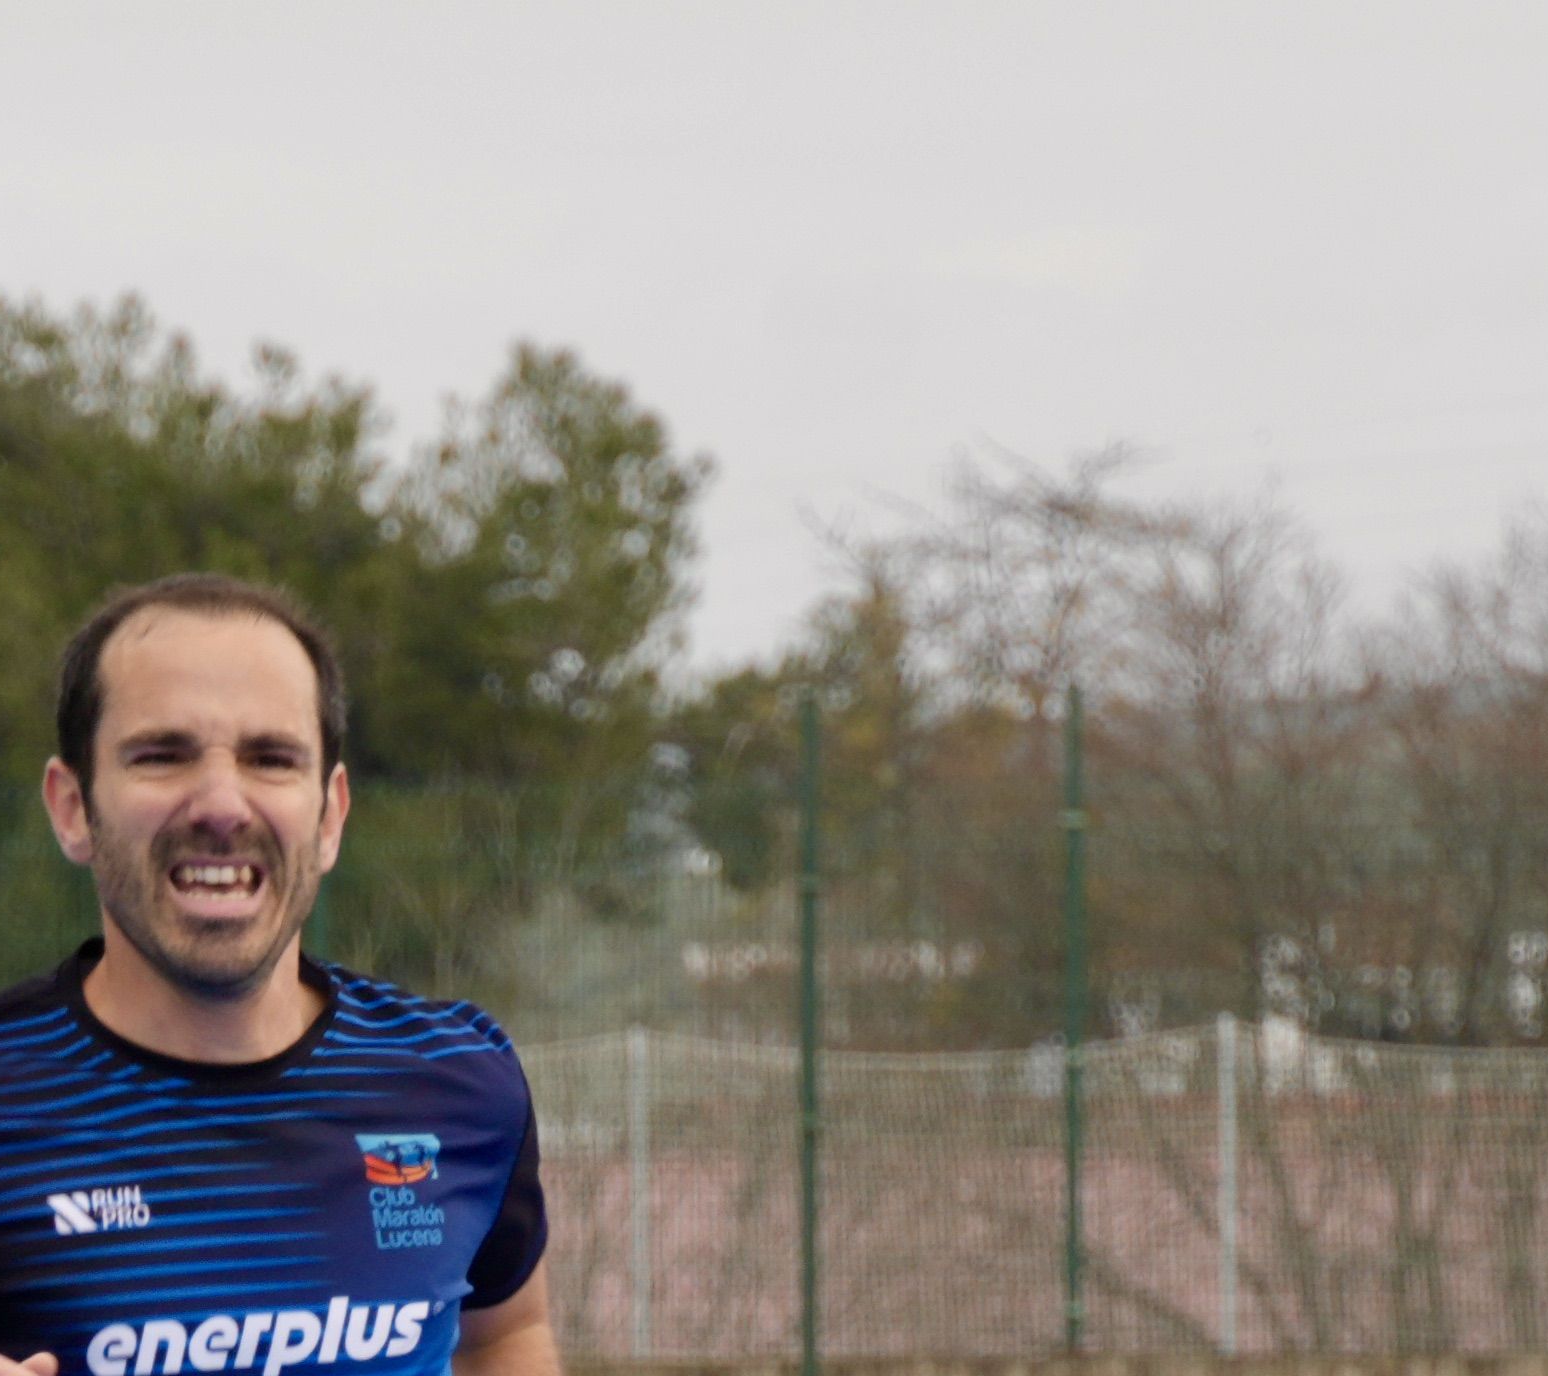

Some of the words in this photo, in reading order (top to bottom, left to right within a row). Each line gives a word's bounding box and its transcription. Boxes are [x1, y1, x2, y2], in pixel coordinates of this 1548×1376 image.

[91, 1185, 141, 1213] RUN
[369, 1186, 415, 1207] Club
[102, 1203, 150, 1231] PRO
[376, 1228, 443, 1249] Lucena
